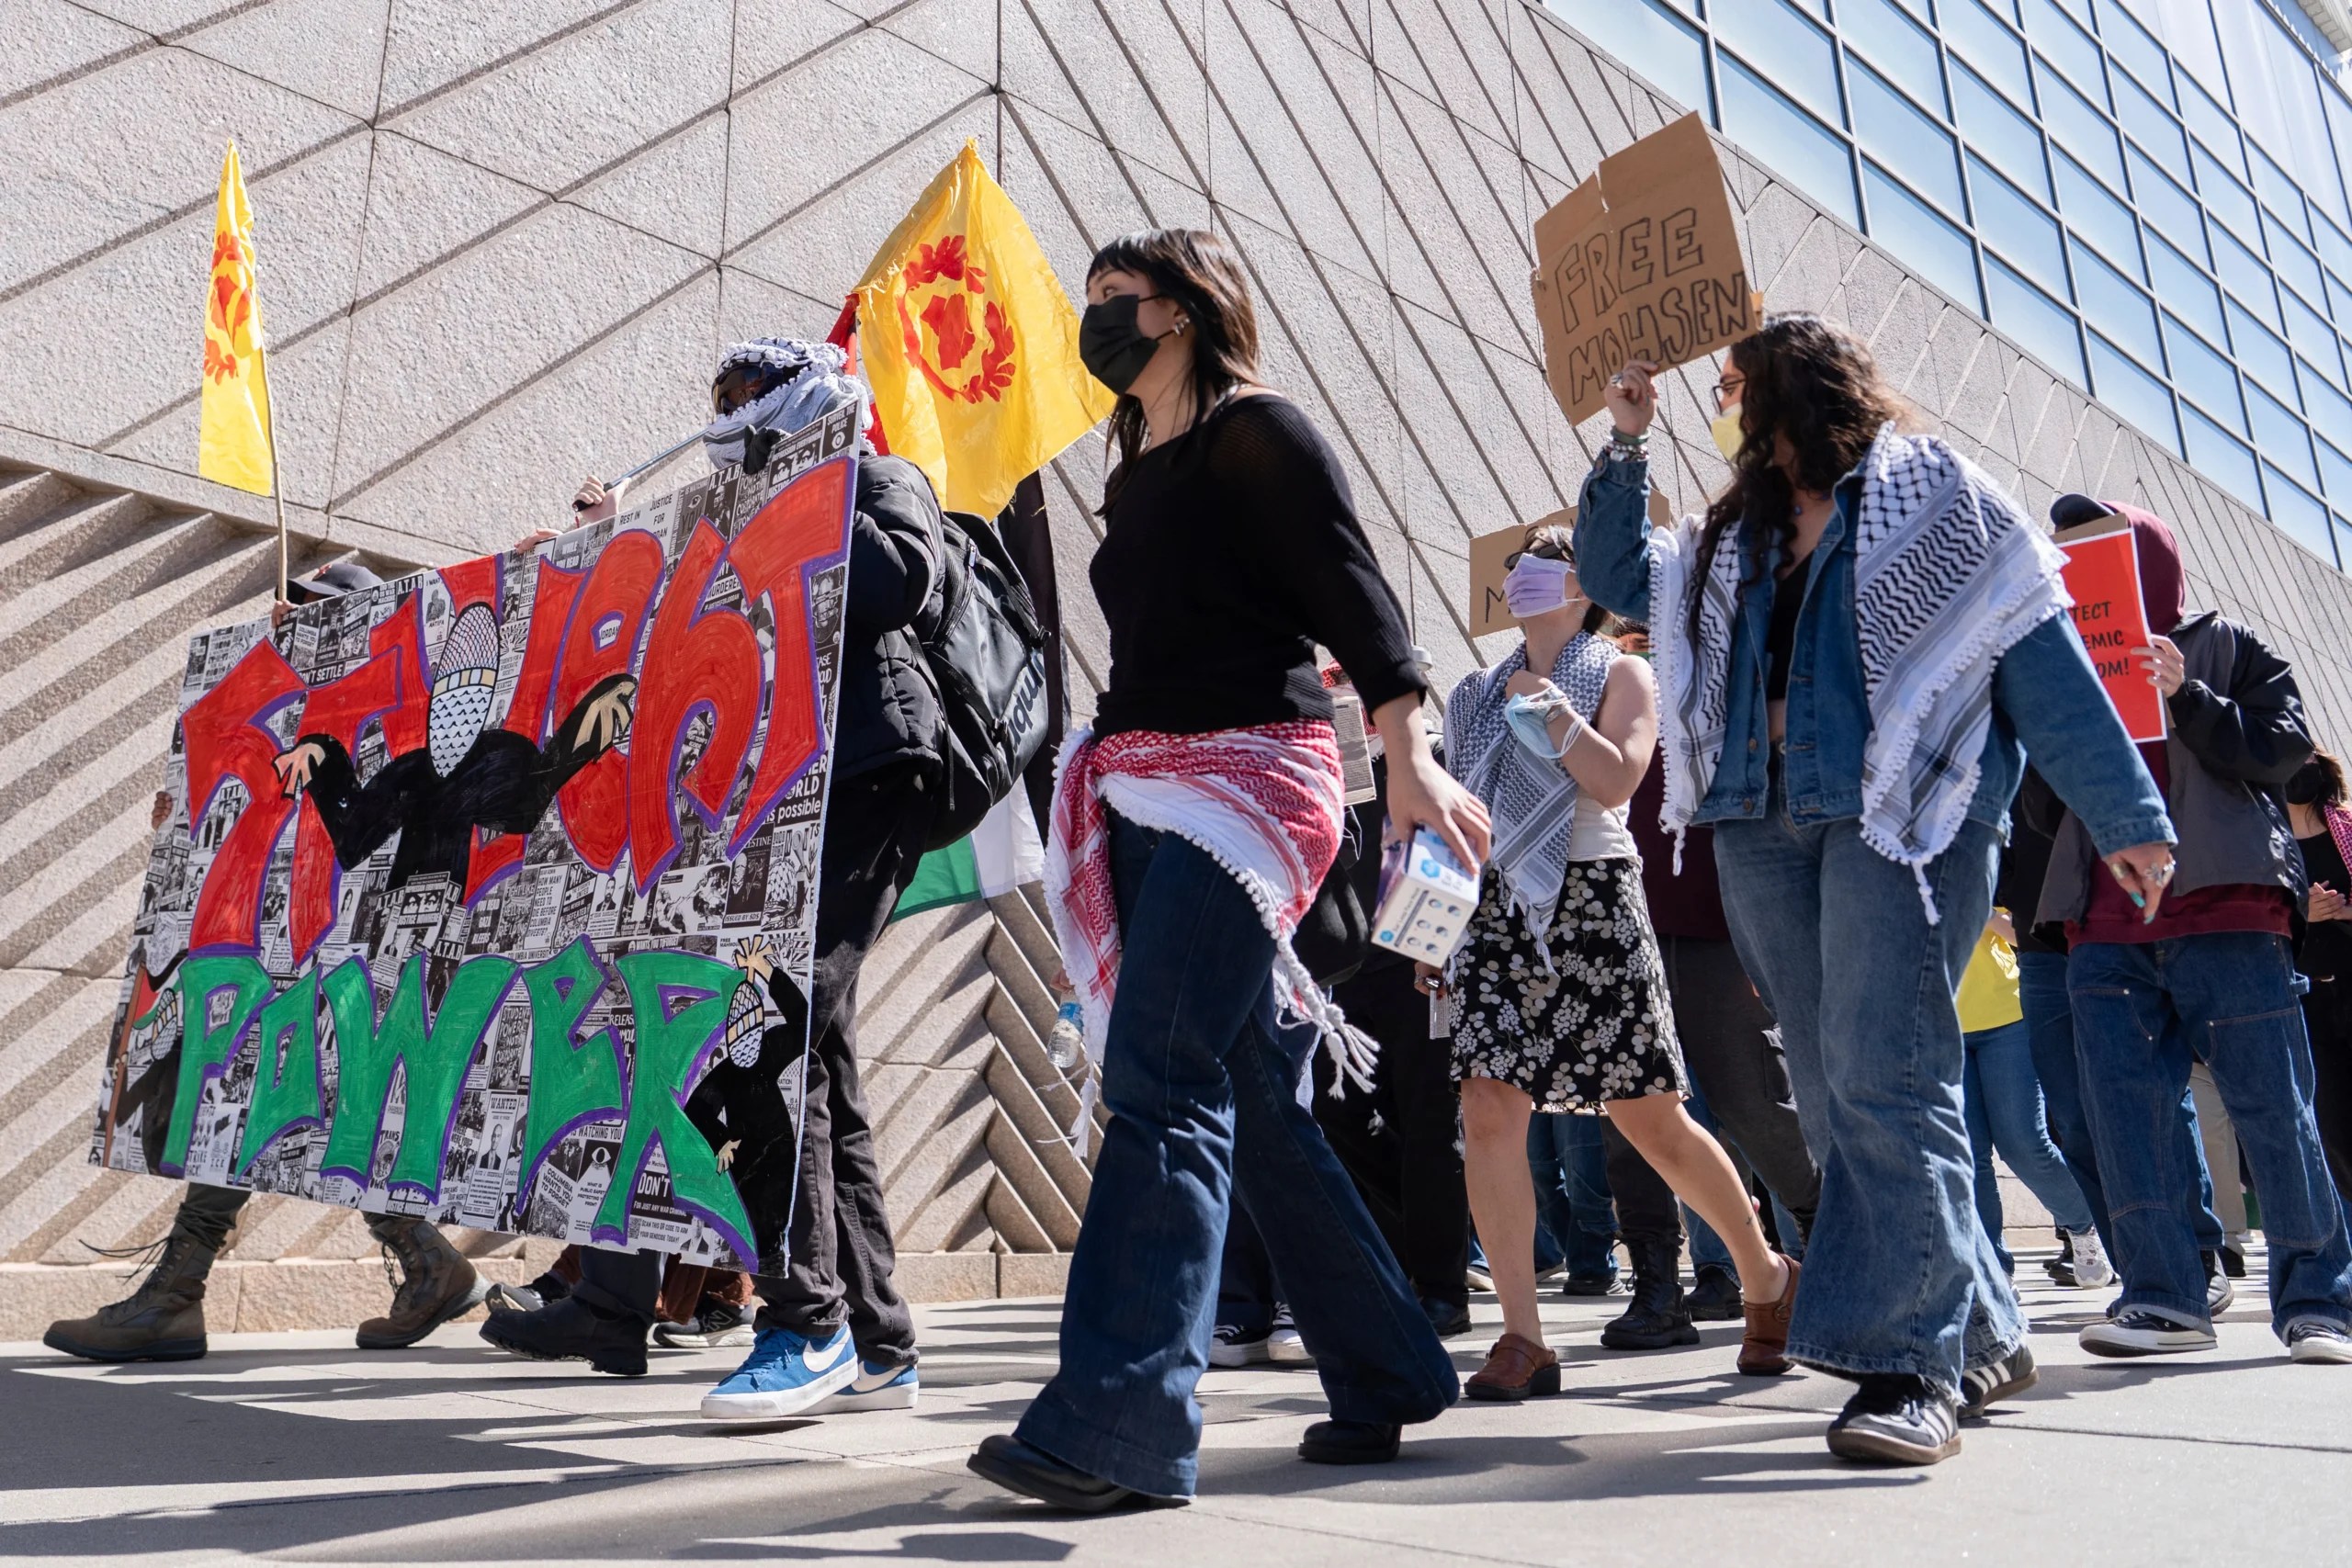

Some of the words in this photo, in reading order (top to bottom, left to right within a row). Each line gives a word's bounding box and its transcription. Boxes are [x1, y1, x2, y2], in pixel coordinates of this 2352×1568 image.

[1555, 207, 1704, 335] FREE
[650, 494, 673, 512] JUSTICE
[619, 513, 634, 525] REST
[634, 510, 641, 522] IN
[653, 513, 665, 525] FOR
[2072, 602, 2112, 622] TECT
[2083, 629, 2125, 650] EMIC
[316, 664, 344, 681] SETTLE
[2098, 657, 2130, 680] OM!
[777, 799, 821, 824] possible
[745, 835, 772, 848] ESTINE
[548, 874, 562, 885] MANY
[446, 885, 460, 902] A.B
[536, 886, 553, 897] PEOPLE
[609, 1013, 634, 1026] RELEAS
[322, 1066, 338, 1077] GAZ
[158, 933, 759, 1273] POWER
[491, 1097, 517, 1111] WANTED
[577, 1126, 608, 1139] WATCHING
[610, 1127, 623, 1140] YOU
[188, 1150, 208, 1164] TRIKE
[543, 1173, 561, 1193] WANTS
[562, 1189, 573, 1202] YOU
[547, 1168, 573, 1193] COLUMBIA
[637, 1172, 670, 1198] DON'T
[541, 1181, 548, 1190] TO
[548, 1187, 570, 1209] FORGET
[641, 1202, 651, 1211] JUST
[651, 1203, 660, 1212] ANY
[660, 1204, 669, 1213] WAR
[651, 1221, 661, 1229] THIS
